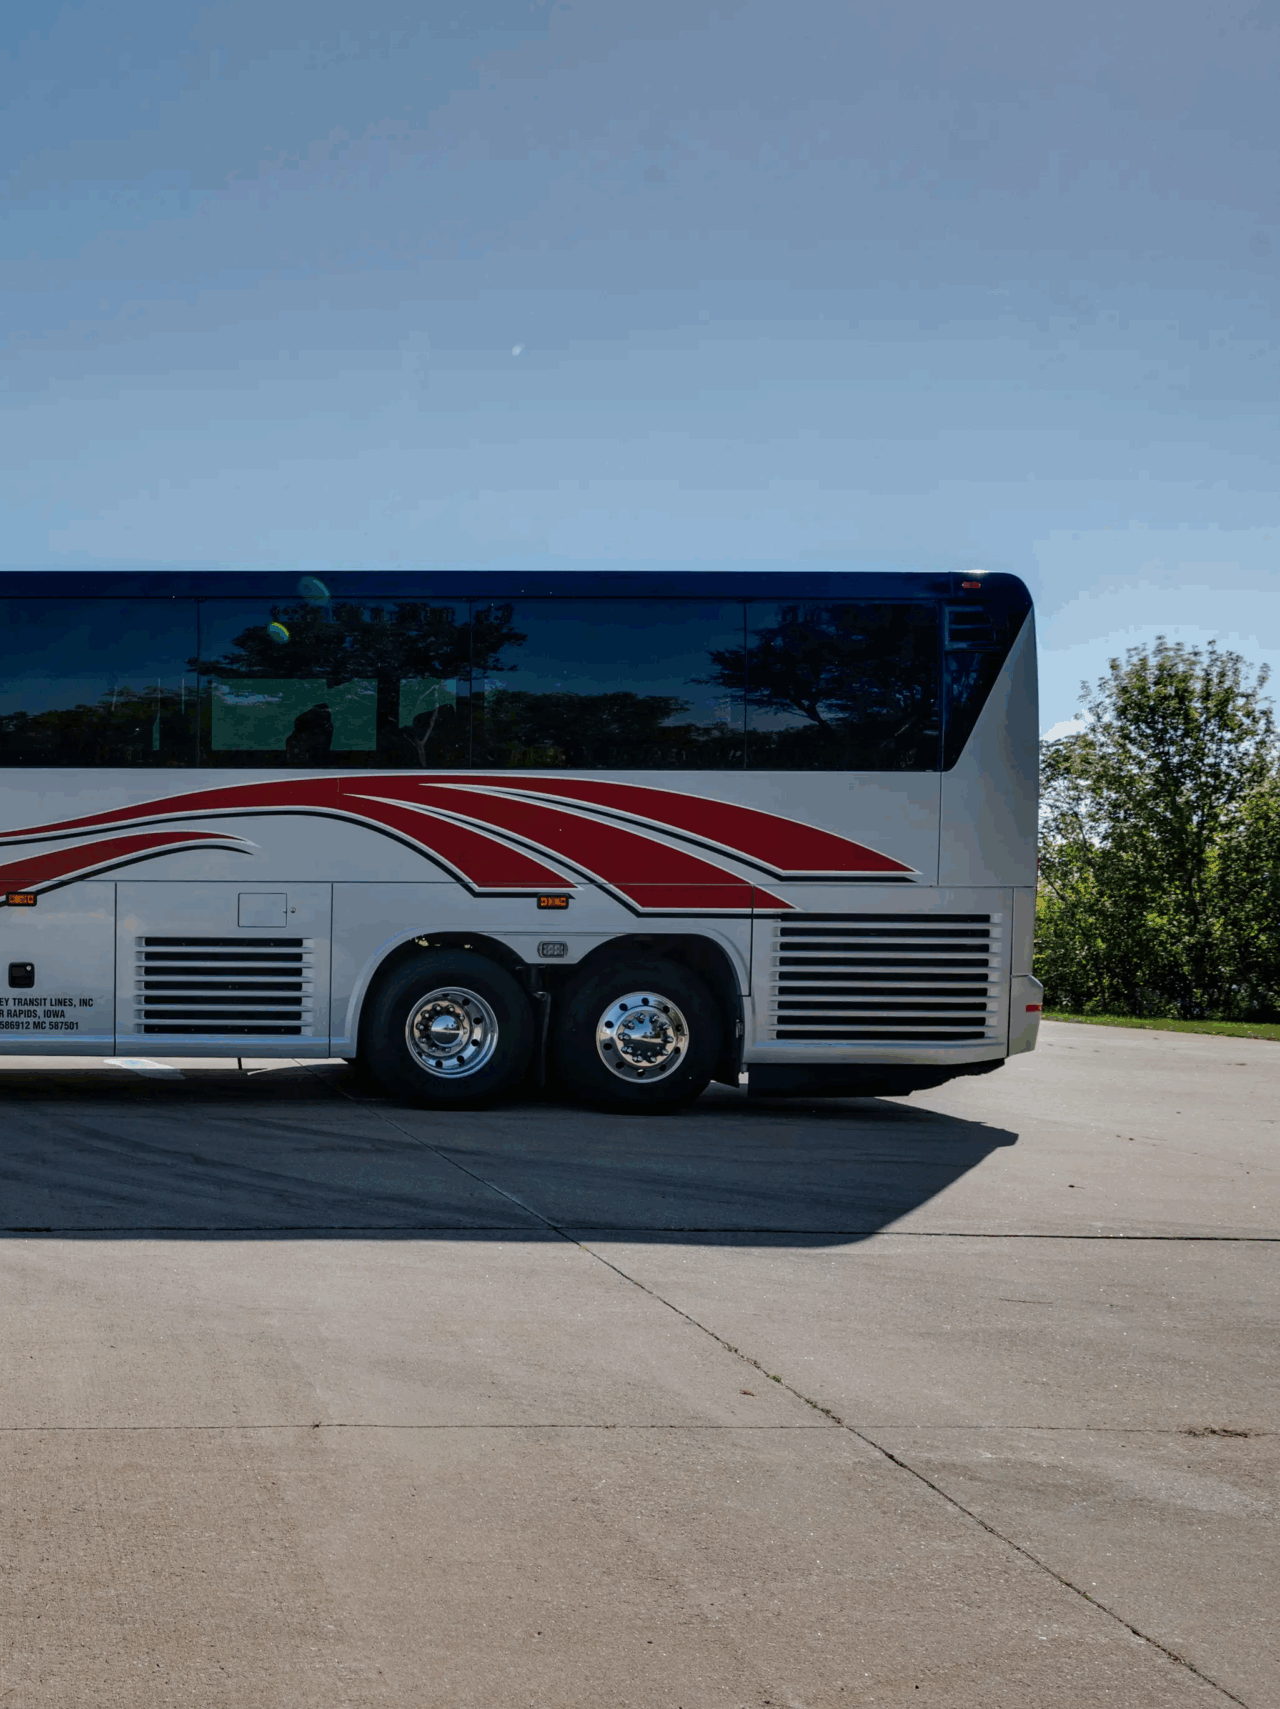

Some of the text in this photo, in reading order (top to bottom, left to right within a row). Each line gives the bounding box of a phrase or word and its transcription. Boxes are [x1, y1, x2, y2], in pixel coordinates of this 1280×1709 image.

[12, 997, 47, 1007] TRANSIT
[49, 997, 77, 1008] LINES,
[79, 998, 94, 1007] INC
[6, 1009, 41, 1019] RAPIDS,
[43, 1009, 66, 1018] IOWA
[32, 1021, 47, 1030] MC
[48, 1021, 79, 1030] 587501
